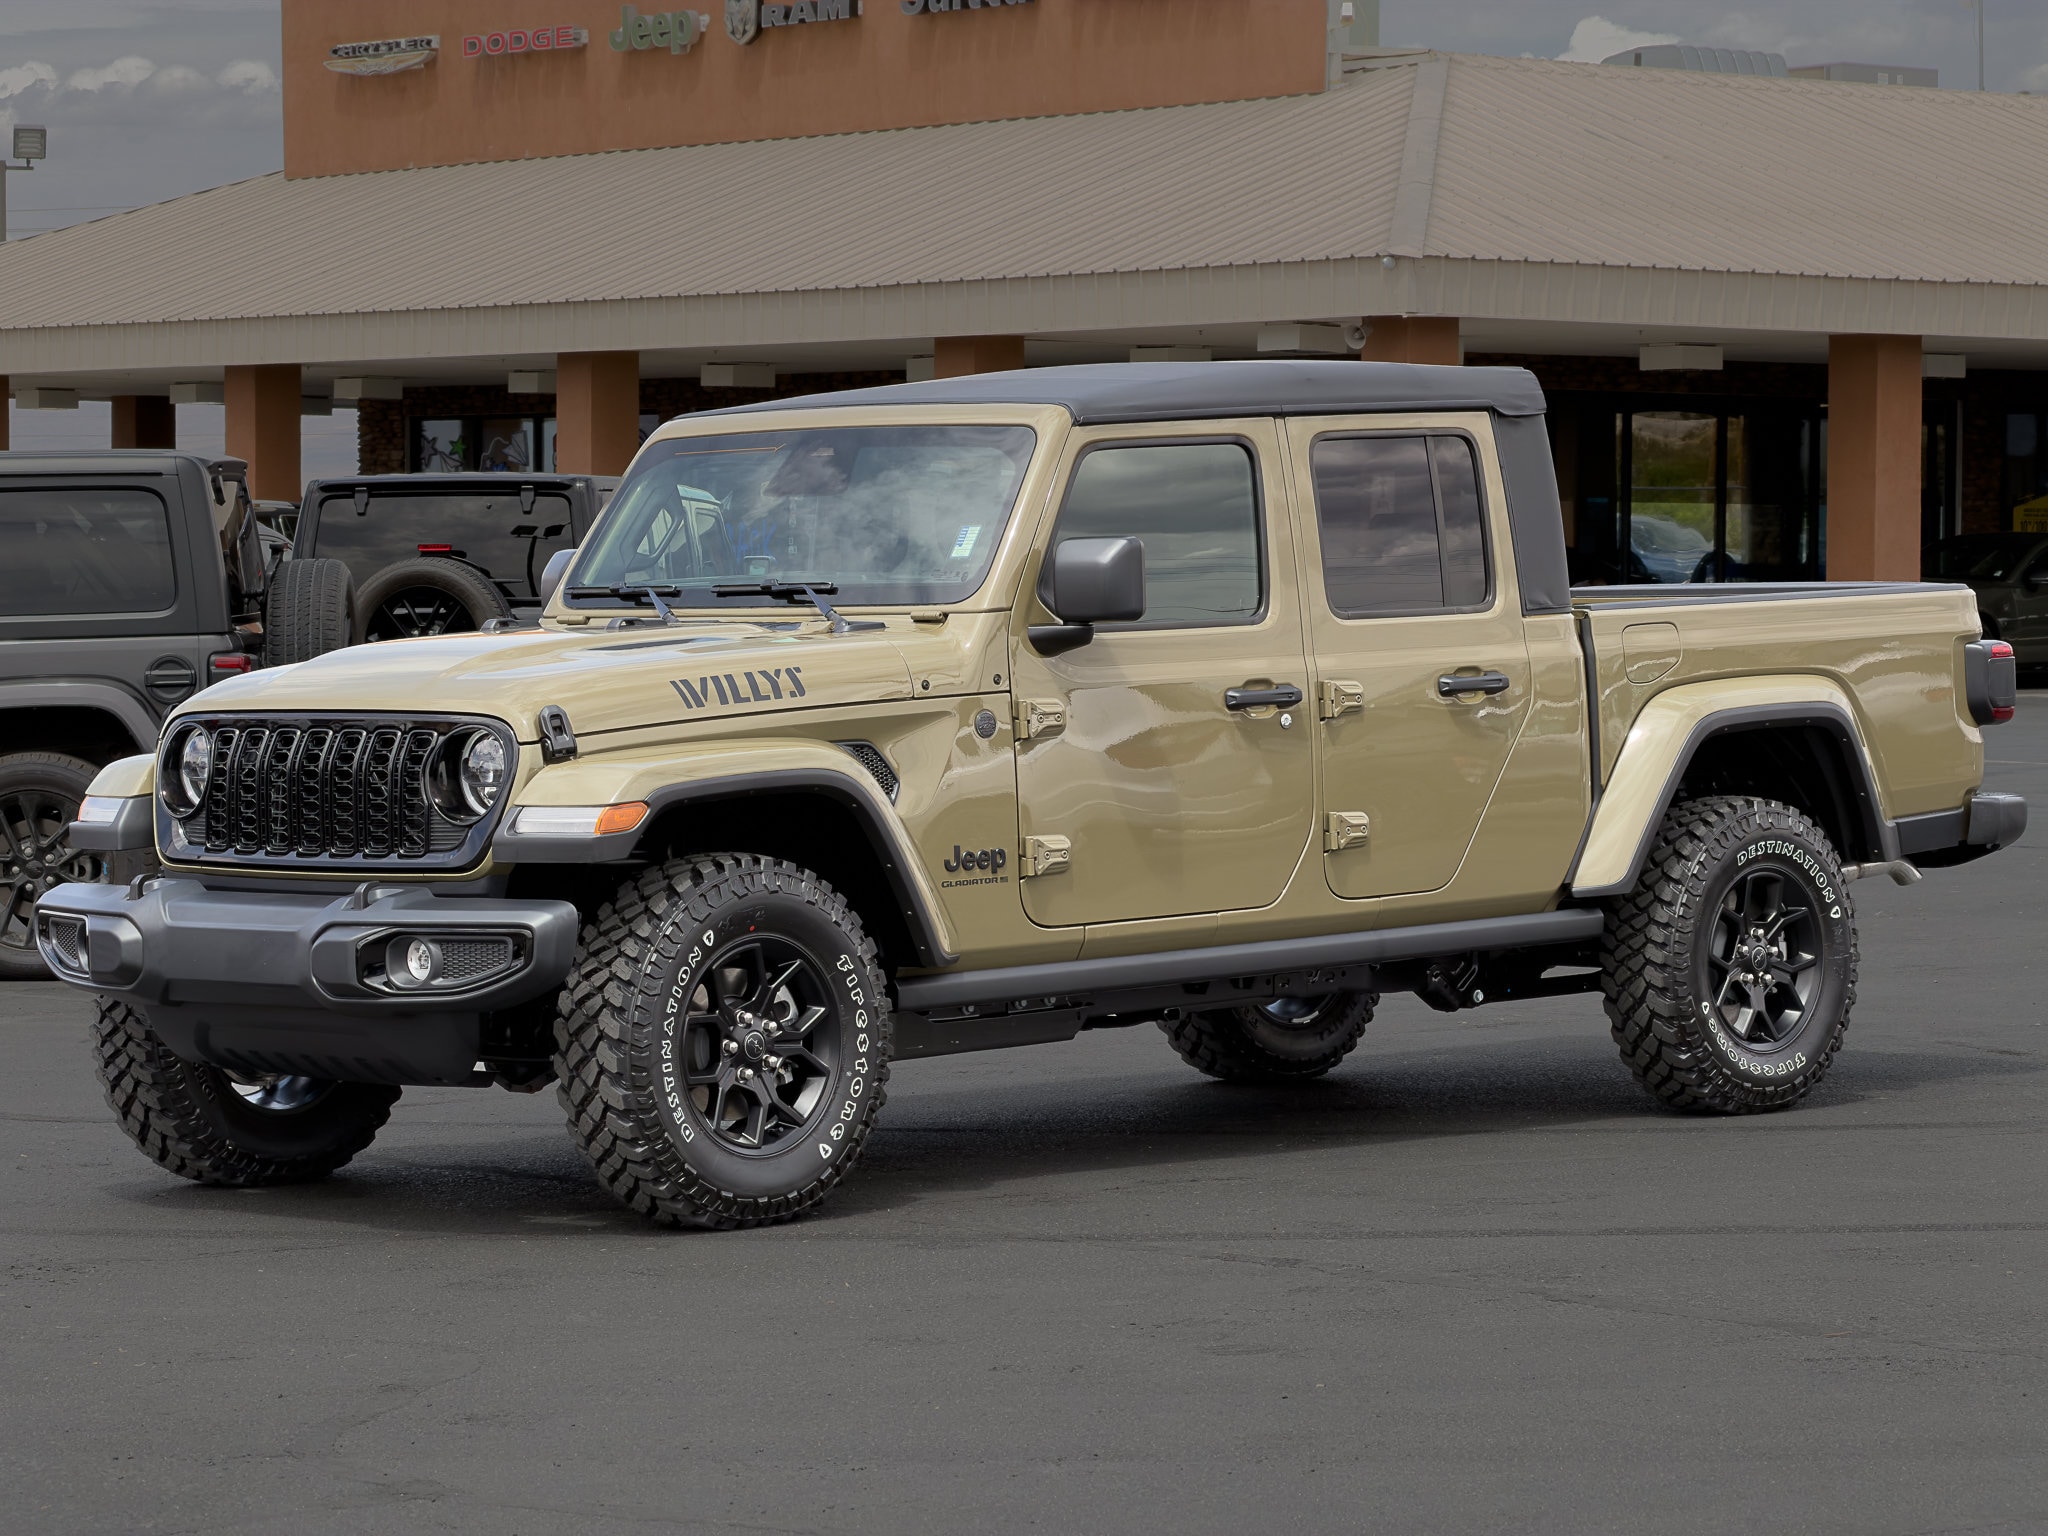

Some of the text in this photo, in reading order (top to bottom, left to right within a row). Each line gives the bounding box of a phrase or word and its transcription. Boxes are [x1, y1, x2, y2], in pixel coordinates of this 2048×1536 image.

[608, 4, 693, 54] Jeep
[761, 0, 850, 28] RAM
[463, 26, 575, 57] DODGE
[669, 666, 806, 709] WILLYS
[943, 845, 1007, 874] Jeep
[1736, 840, 1836, 903] DESTINATION
[941, 876, 999, 888] GLADIATOR
[660, 946, 702, 1143] DESTINATION
